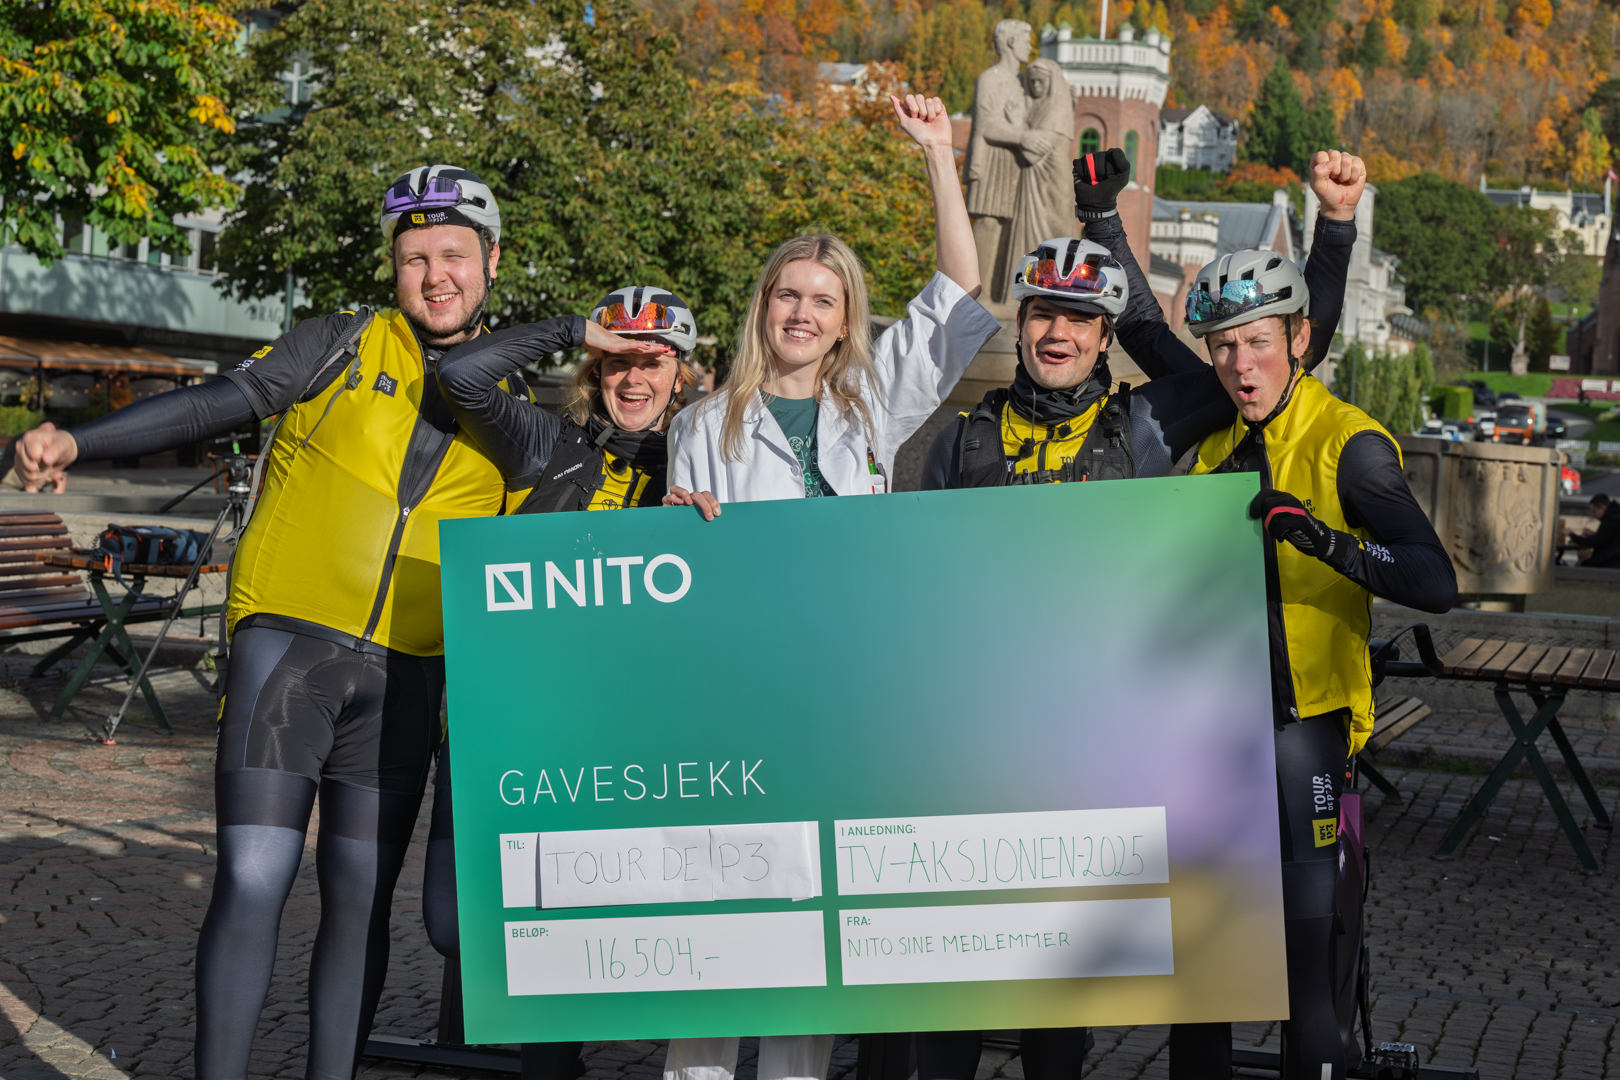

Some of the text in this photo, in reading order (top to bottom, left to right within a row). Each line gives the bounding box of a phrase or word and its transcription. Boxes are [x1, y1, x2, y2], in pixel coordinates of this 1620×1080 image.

[545, 553, 692, 609] NITO
[499, 759, 766, 806] GAVESJEKK
[1312, 775, 1327, 813] TOUR
[847, 824, 916, 836] ANLEDNING:
[506, 840, 525, 850] TIL:
[545, 842, 770, 884] TOUR DE P3
[512, 927, 549, 938] BELØP:
[846, 916, 871, 926] FRA:
[847, 931, 1071, 958] NITO SINE MEDLEMMER
